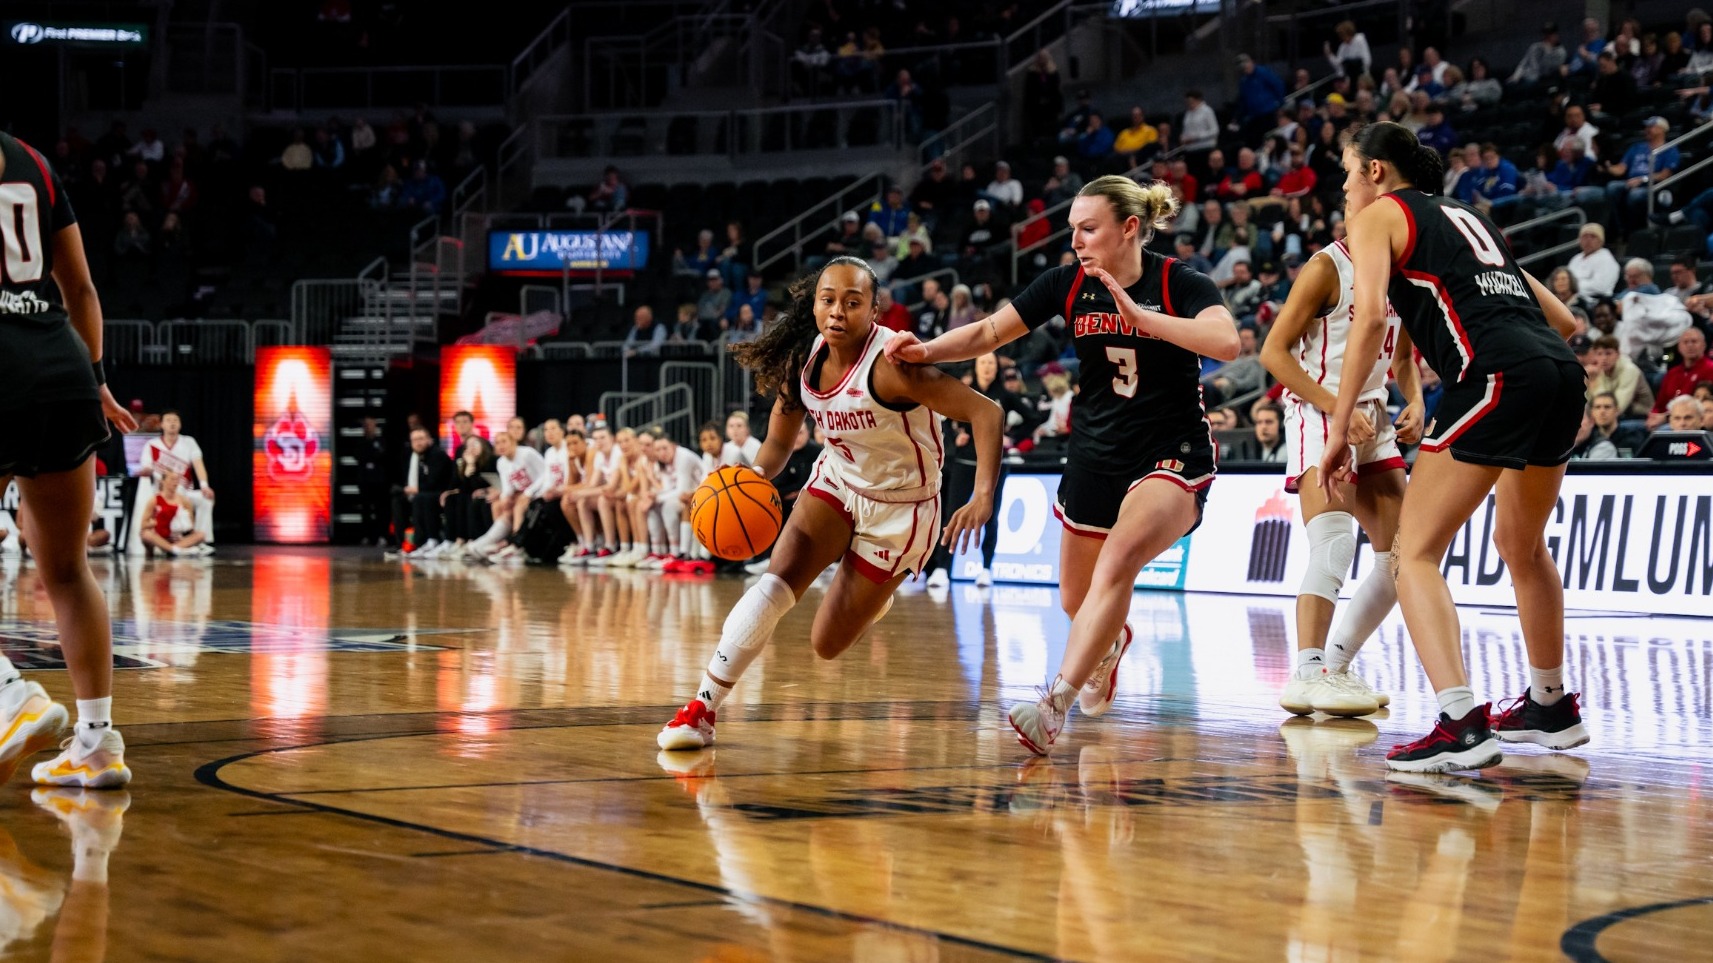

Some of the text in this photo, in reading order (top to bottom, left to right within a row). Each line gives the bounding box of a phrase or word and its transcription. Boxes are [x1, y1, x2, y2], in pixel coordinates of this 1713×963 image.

[1440, 205, 1505, 267] 0
[1074, 312, 1163, 341] DENV
[1378, 326, 1394, 359] 4
[1105, 346, 1139, 398] 3
[827, 410, 877, 430] DAKOTA
